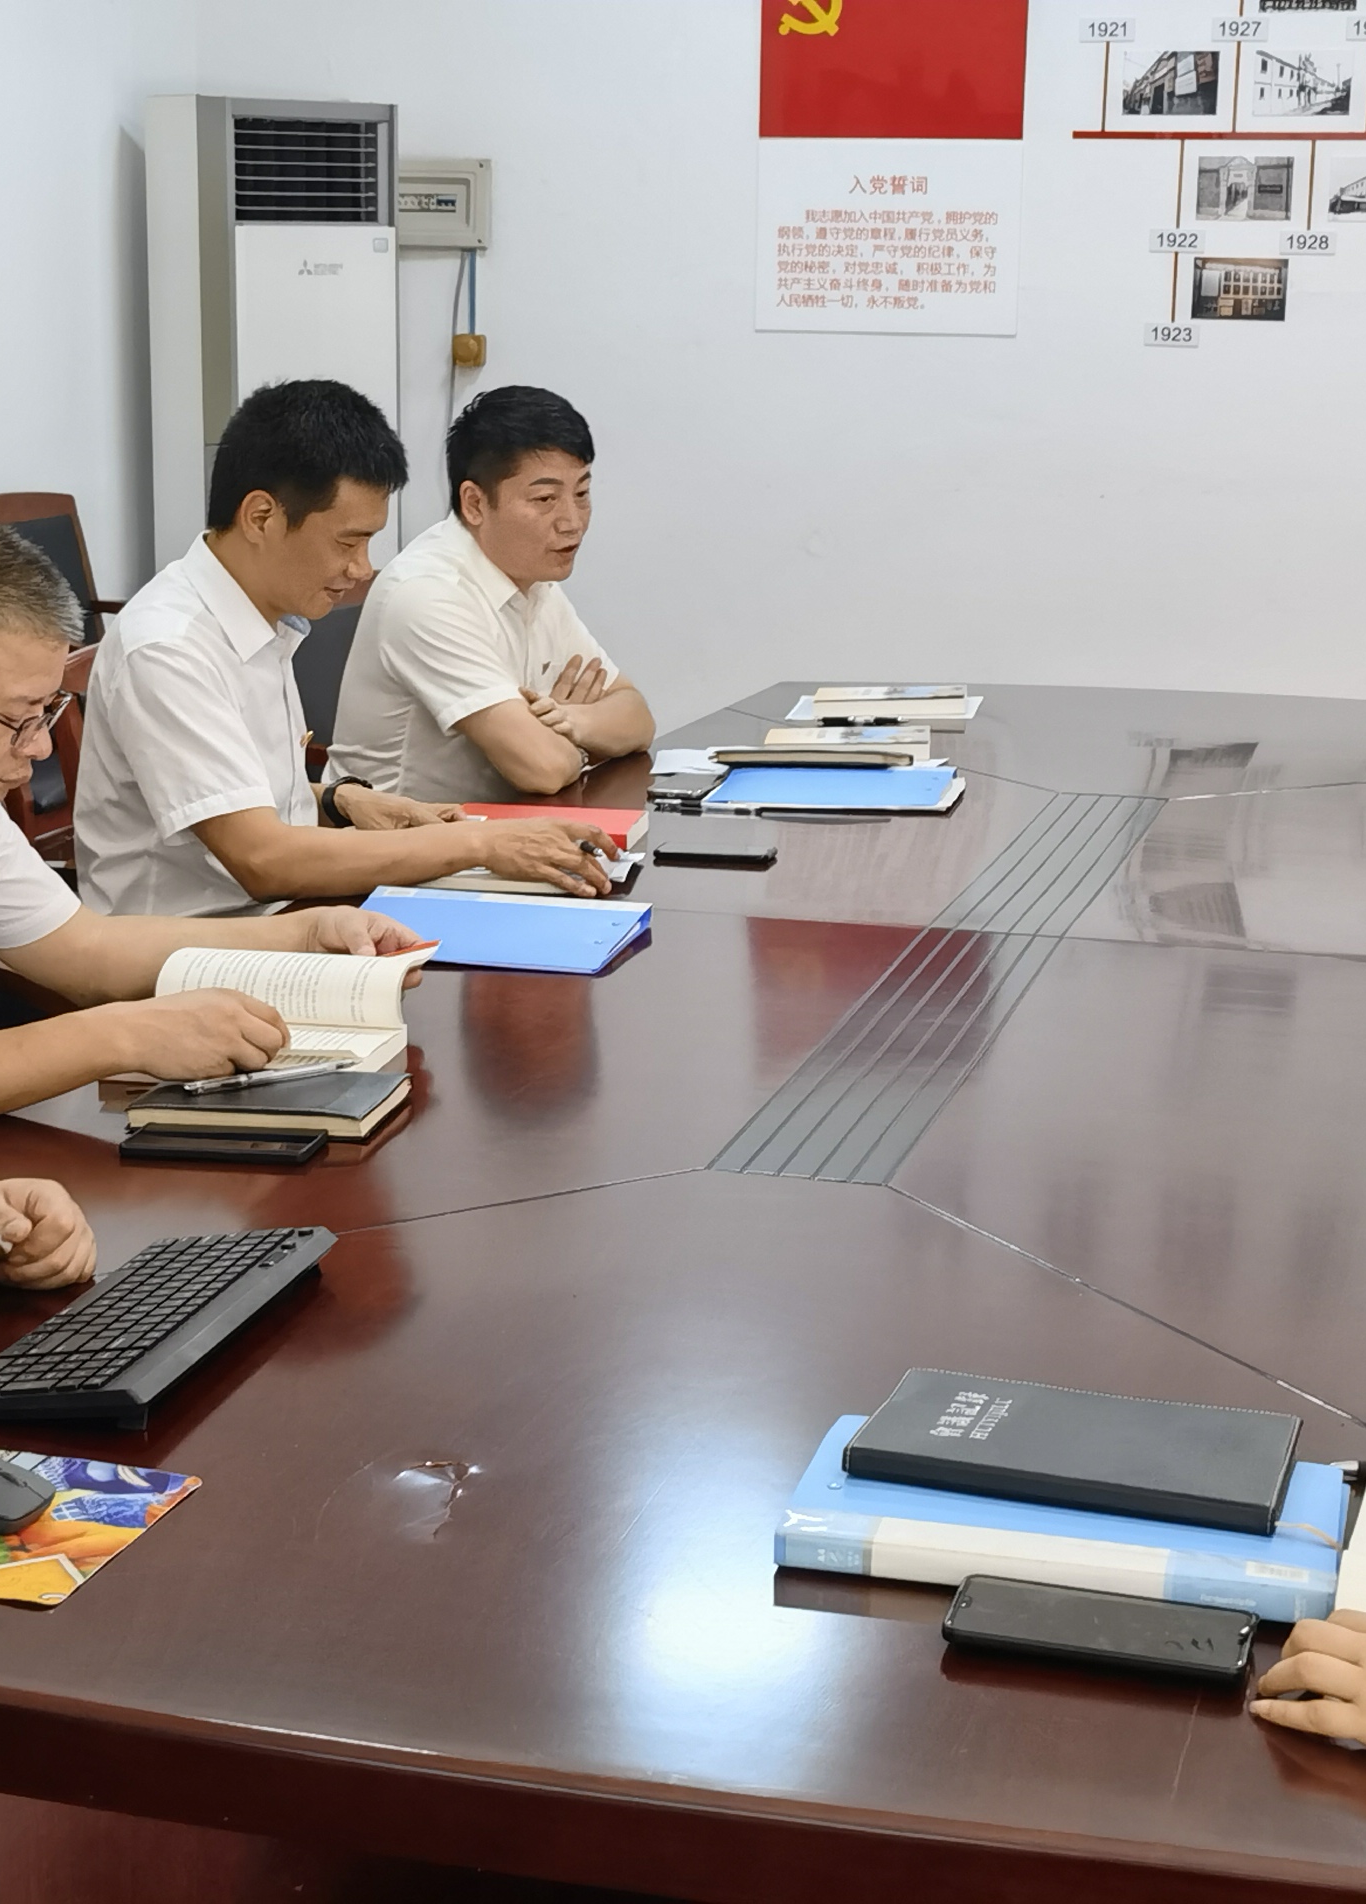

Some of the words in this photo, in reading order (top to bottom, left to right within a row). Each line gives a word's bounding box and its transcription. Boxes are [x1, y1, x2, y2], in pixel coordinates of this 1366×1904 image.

[1088, 21, 1128, 38] 1921
[1219, 20, 1262, 37] 1927
[848, 174, 928, 196] 入党誓词
[1157, 232, 1199, 249] 1922
[1286, 234, 1330, 251] 1928
[1151, 326, 1193, 343] 1923
